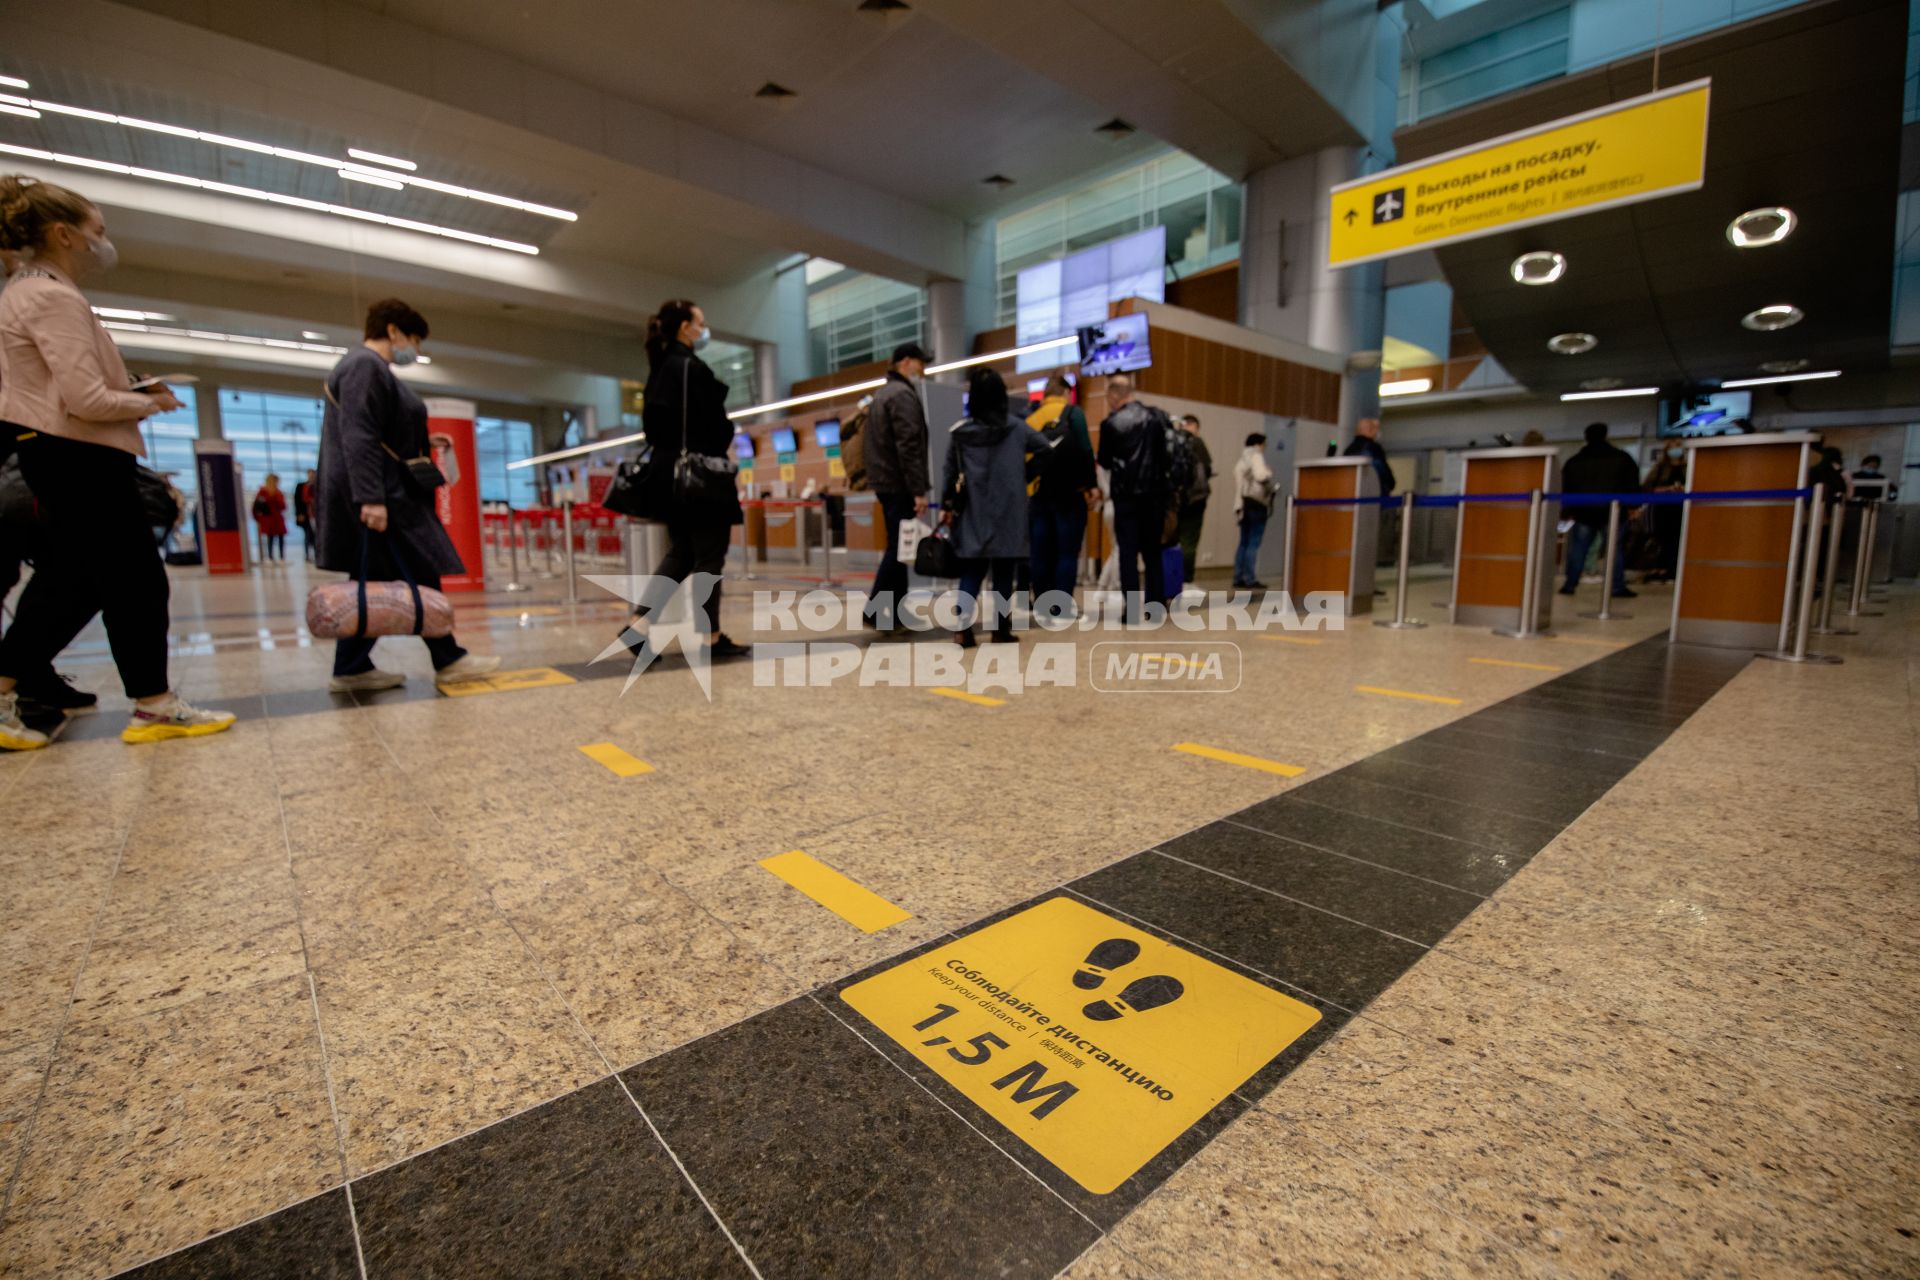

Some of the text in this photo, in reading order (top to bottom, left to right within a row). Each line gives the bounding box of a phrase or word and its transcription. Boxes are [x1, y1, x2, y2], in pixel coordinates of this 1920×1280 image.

[1415, 182, 1520, 217] Внутренние
[1524, 164, 1587, 193] рейсы
[1416, 170, 1487, 198] Выходы
[1490, 163, 1512, 177] на
[1449, 204, 1503, 228] Domestic
[1507, 196, 1546, 215] flights
[928, 967, 1028, 1032] Keep your distance
[912, 1003, 1011, 1066] 1,5
[946, 959, 1174, 1102] Соблюдайте дистанцию
